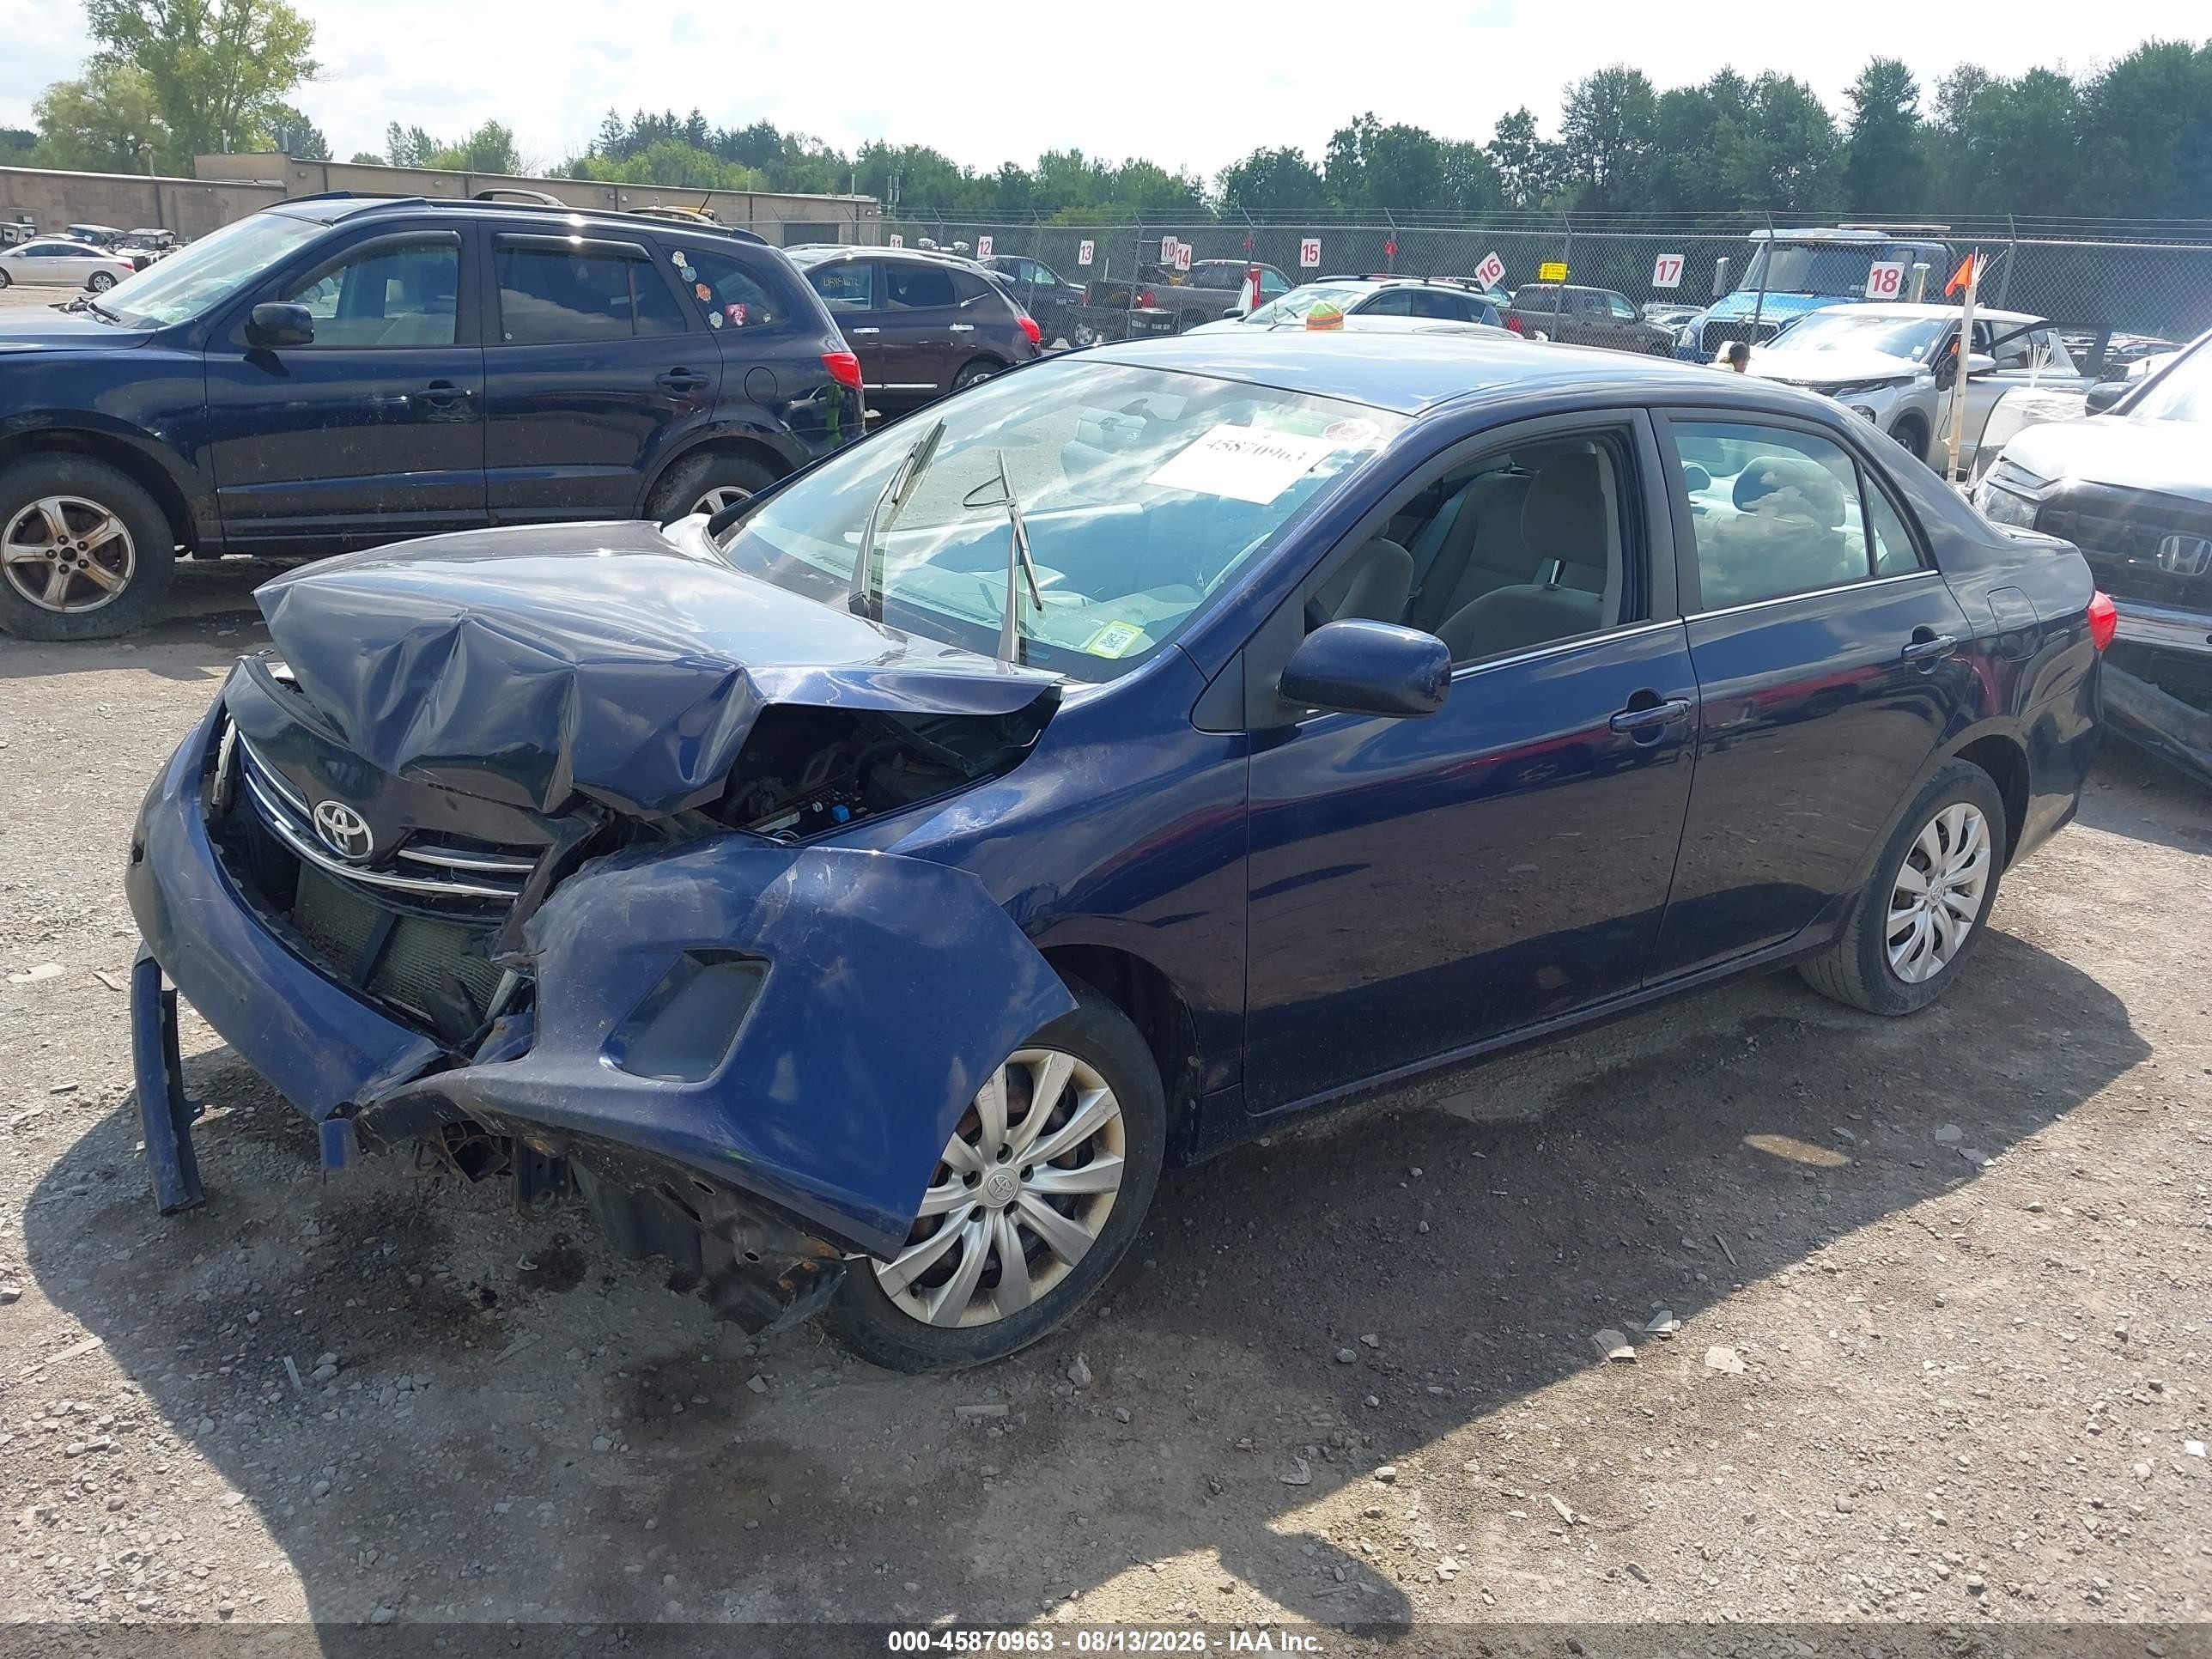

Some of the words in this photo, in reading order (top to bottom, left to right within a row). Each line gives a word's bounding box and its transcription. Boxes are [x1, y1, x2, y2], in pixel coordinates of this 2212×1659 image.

[979, 240, 991, 256] 12
[1081, 245, 1092, 261] 13
[1164, 242, 1176, 258] 10
[1177, 248, 1189, 266] 14
[1303, 244, 1318, 263] 15
[1479, 258, 1501, 283] 16
[1658, 260, 1680, 282] 17
[1872, 268, 1899, 293] 18
